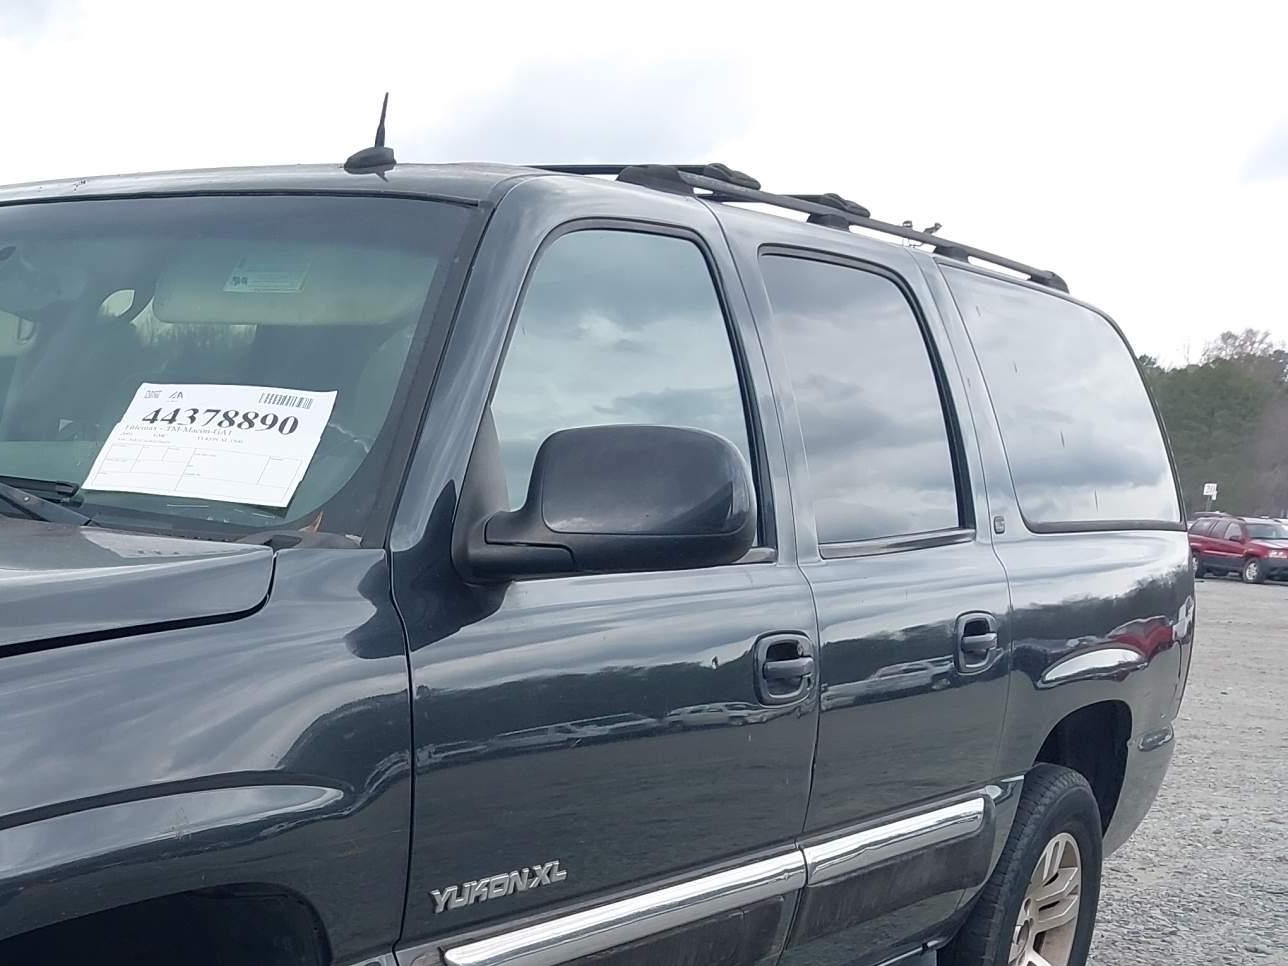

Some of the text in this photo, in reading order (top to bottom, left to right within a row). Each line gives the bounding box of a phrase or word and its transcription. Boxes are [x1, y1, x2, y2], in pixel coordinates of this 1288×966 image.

[142, 407, 299, 436] 44378890
[430, 860, 568, 914] YUKON XL
